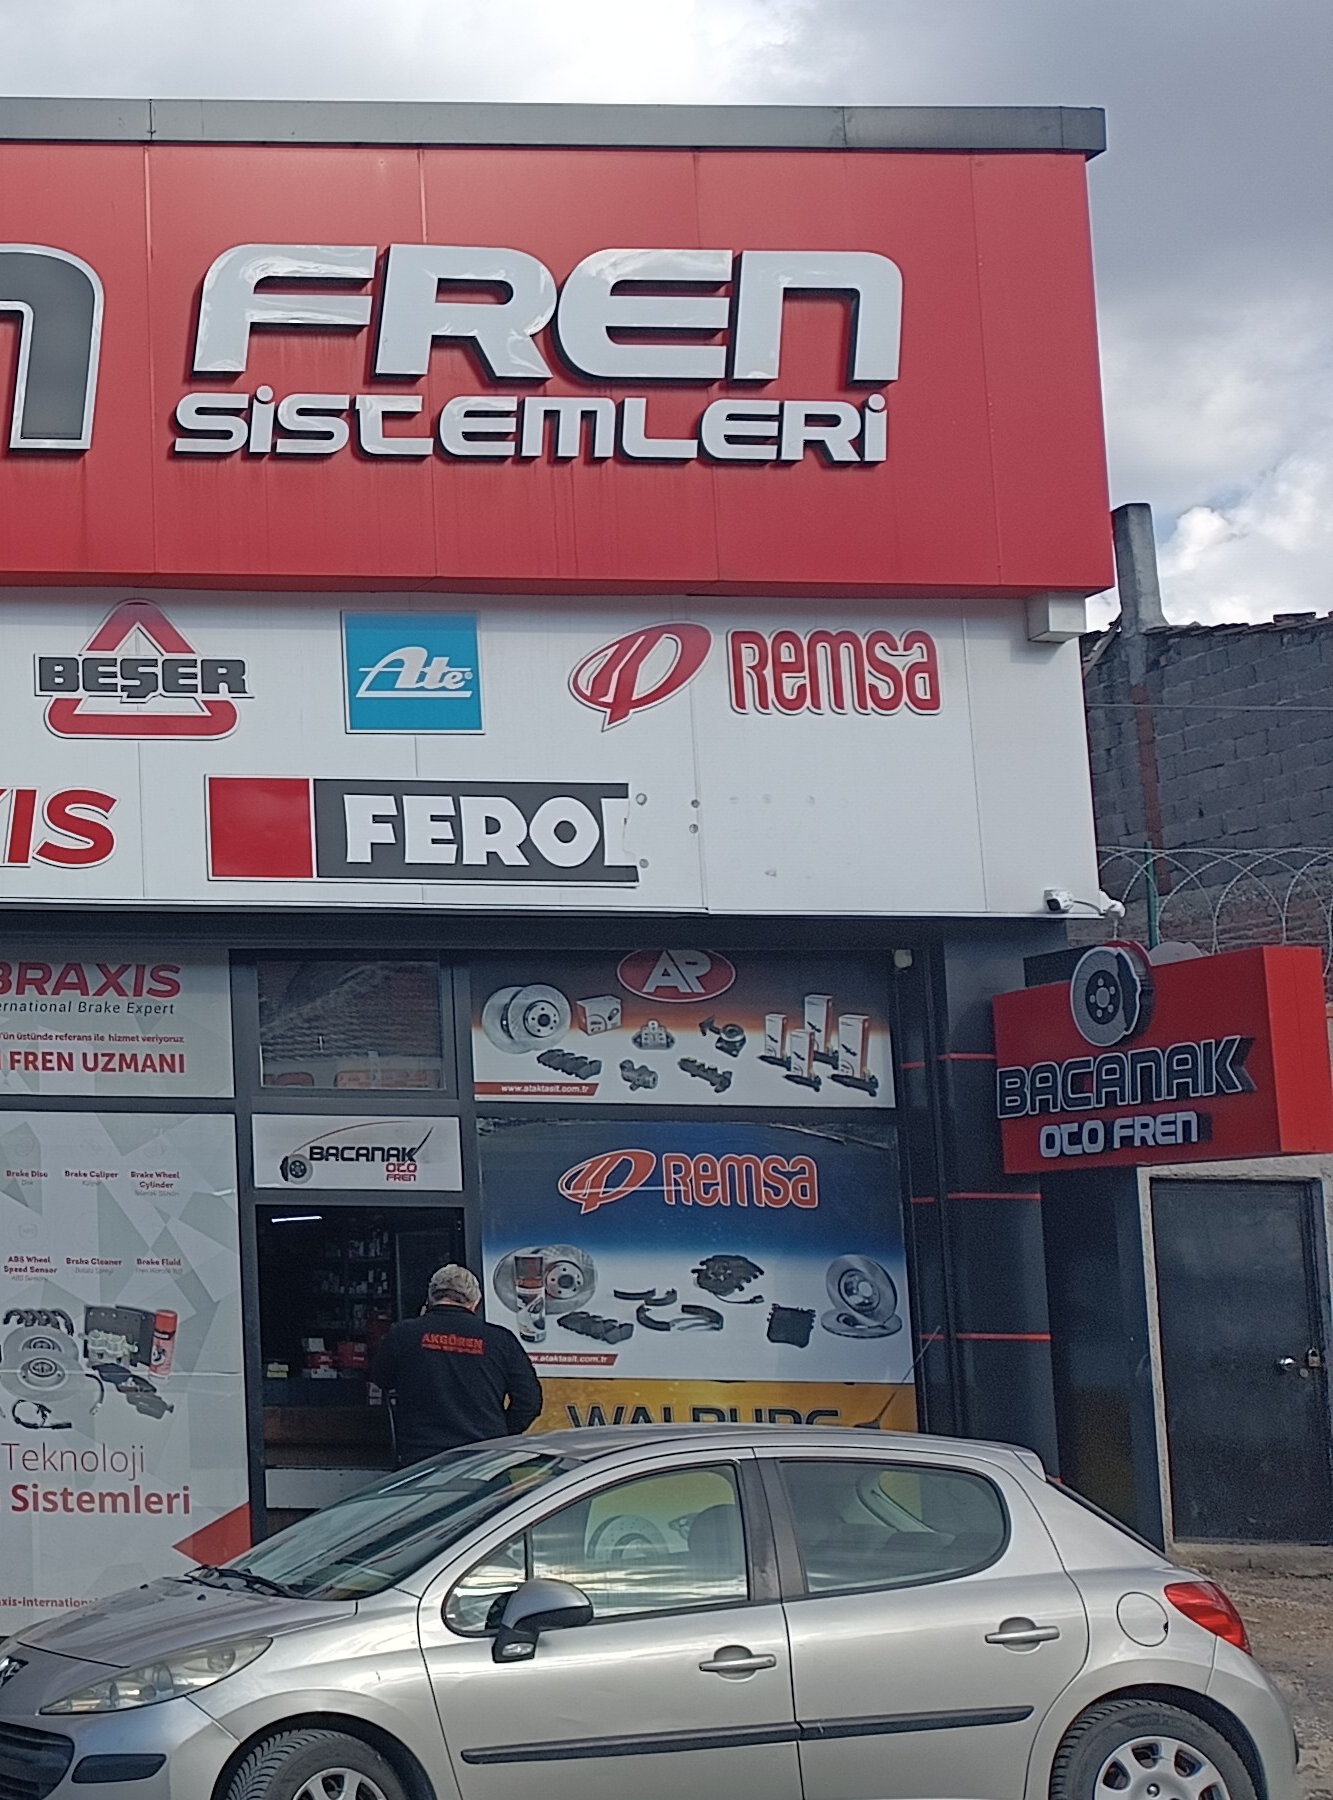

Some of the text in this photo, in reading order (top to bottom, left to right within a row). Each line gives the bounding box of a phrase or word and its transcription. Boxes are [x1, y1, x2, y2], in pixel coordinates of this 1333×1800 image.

[193, 243, 903, 381] FREN
[78, 1001, 120, 1014] Brake
[127, 1002, 175, 1017] Expert
[16, 1033, 53, 1041] üstünde
[55, 1033, 92, 1042] referans
[94, 1033, 105, 1042] ile
[108, 1034, 139, 1043] hizmet
[141, 1035, 185, 1045] veriyoruz
[9, 1051, 74, 1072] FREN
[82, 1052, 185, 1073] UZMANI
[996, 1034, 1246, 1119] BACANAK
[1039, 1110, 1198, 1158] OTO FREN
[308, 1145, 417, 1163] BACANAK
[385, 1162, 418, 1173] OTO
[386, 1173, 416, 1182] FREN
[1, 1442, 146, 1482] Teknoloji
[10, 1484, 192, 1515] Sistemleri
